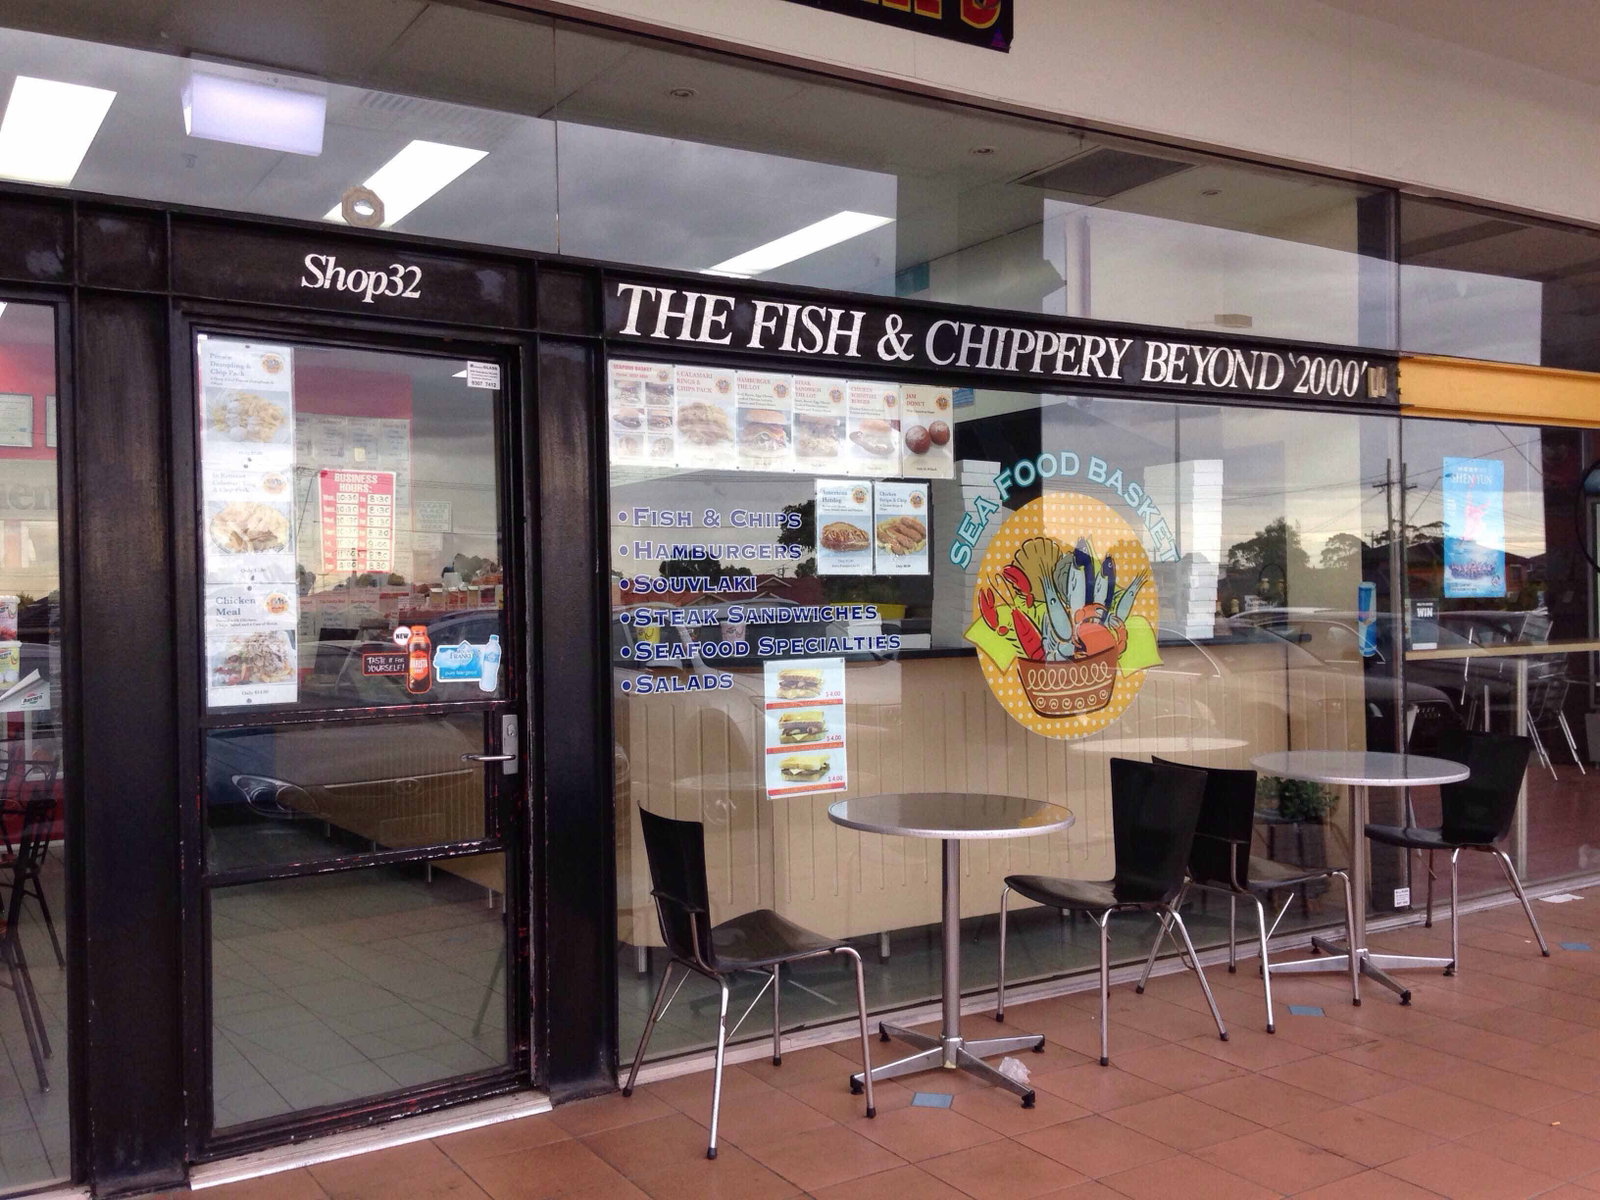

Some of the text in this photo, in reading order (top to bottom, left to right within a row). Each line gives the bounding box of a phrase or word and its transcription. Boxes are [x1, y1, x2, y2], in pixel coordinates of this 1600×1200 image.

[300, 253, 422, 304] Shop32
[616, 282, 736, 346] THE
[746, 299, 867, 358] FISH
[876, 313, 915, 363] &
[925, 319, 1134, 381] CHIPPERY
[1141, 340, 1286, 391] BEYOND
[334, 472, 379, 485] BUSINESS
[993, 450, 1081, 502] FOOD
[1087, 455, 1181, 564] BASKET
[631, 506, 803, 530] FISH & CHIPS
[633, 541, 802, 562] HAMBURGERS
[633, 574, 758, 594] SOUVLAKI
[215, 595, 256, 605] Chicken
[215, 607, 241, 616] Meal
[634, 604, 879, 628] STEAK SANDWICHES
[1416, 607, 1434, 618] WIN
[395, 632, 410, 640] NEW
[634, 634, 902, 662] SEAFOOD SPECIALTIES
[635, 673, 735, 695] SALADS
